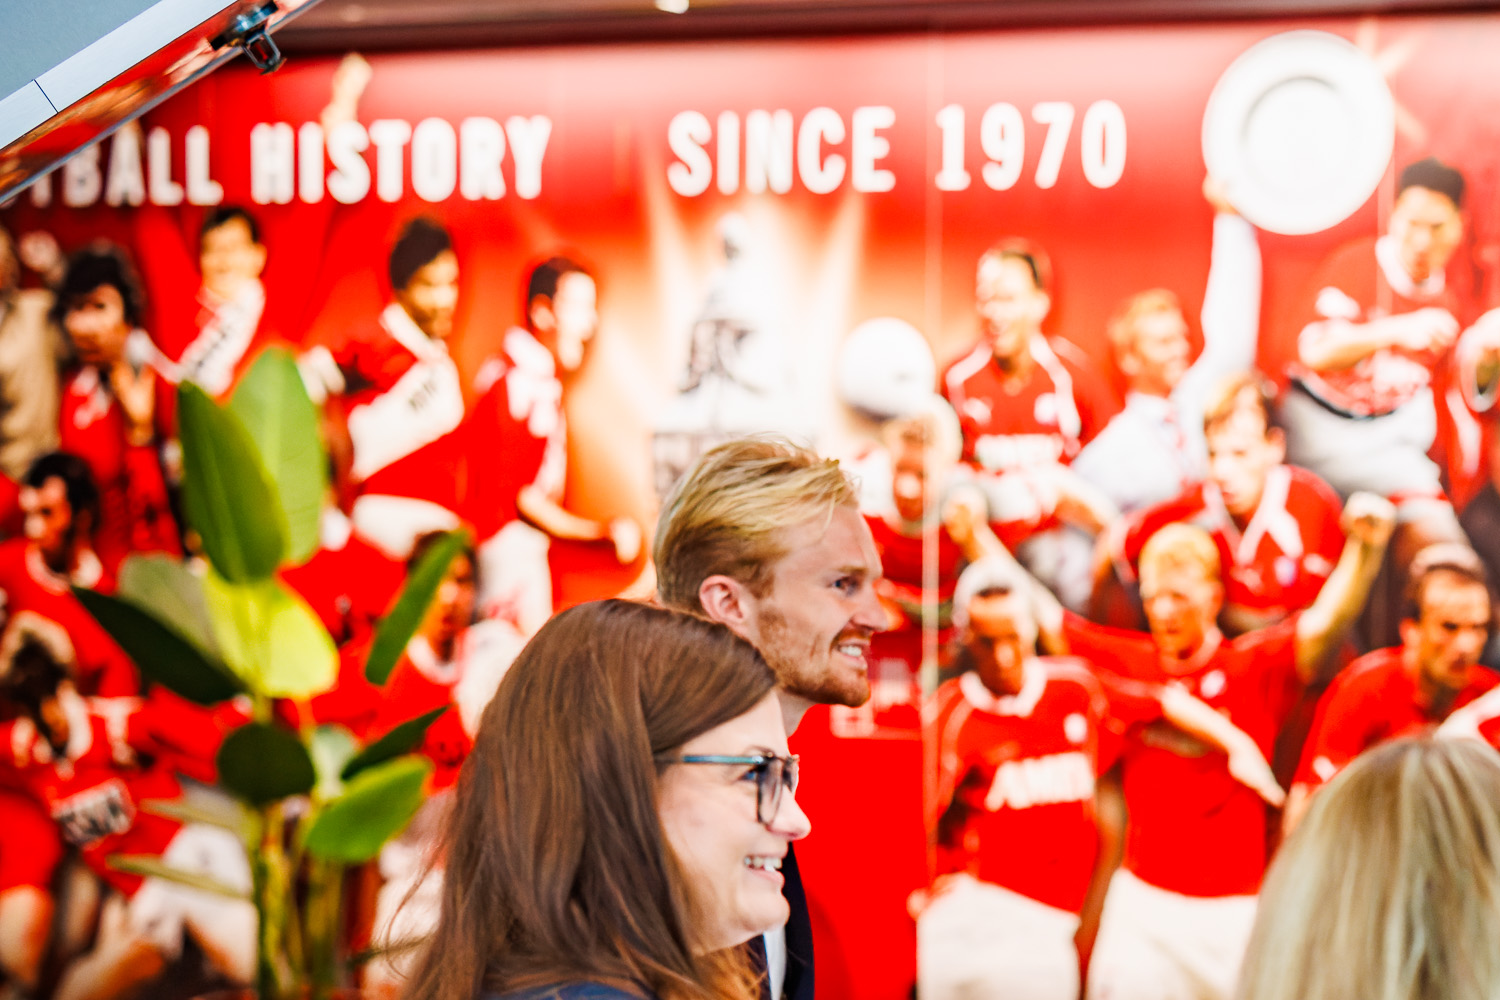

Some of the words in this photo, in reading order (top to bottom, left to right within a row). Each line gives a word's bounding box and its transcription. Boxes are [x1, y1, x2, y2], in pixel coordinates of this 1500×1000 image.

[0, 124, 225, 208] BALL
[250, 114, 552, 206] HISTORY
[667, 105, 897, 197] SINCE
[934, 99, 1128, 193] 1970
